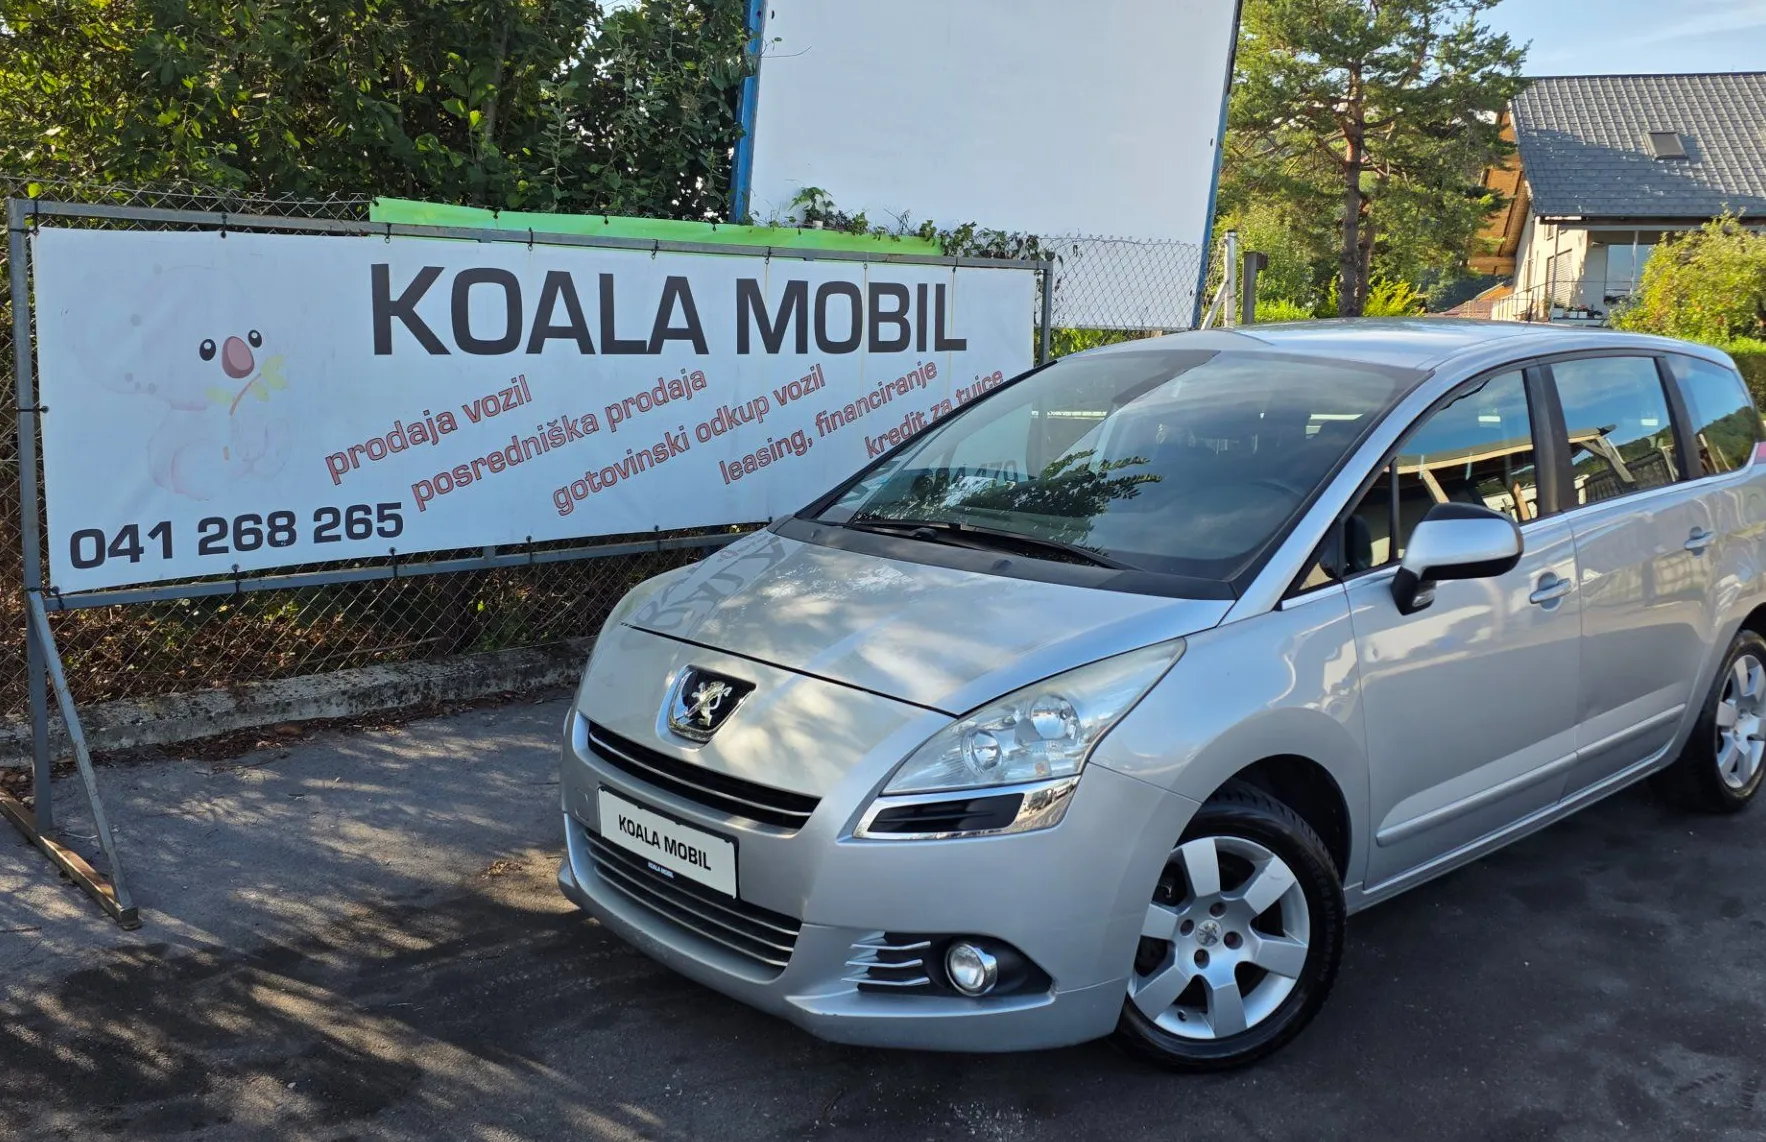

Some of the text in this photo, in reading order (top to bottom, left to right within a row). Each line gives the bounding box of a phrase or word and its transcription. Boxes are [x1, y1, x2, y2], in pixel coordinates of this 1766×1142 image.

[370, 263, 967, 355] KOALA MOBIL
[325, 374, 533, 485] prodaja vozil
[411, 368, 707, 512] posredniška prodaja
[552, 363, 826, 516] gotovinski odkup vozil
[719, 360, 938, 485] leasing, financiranje
[864, 411, 928, 459] kredit
[930, 398, 953, 421] za
[70, 502, 404, 569] 041 268 265
[618, 814, 711, 871] KOALA MOBIL
